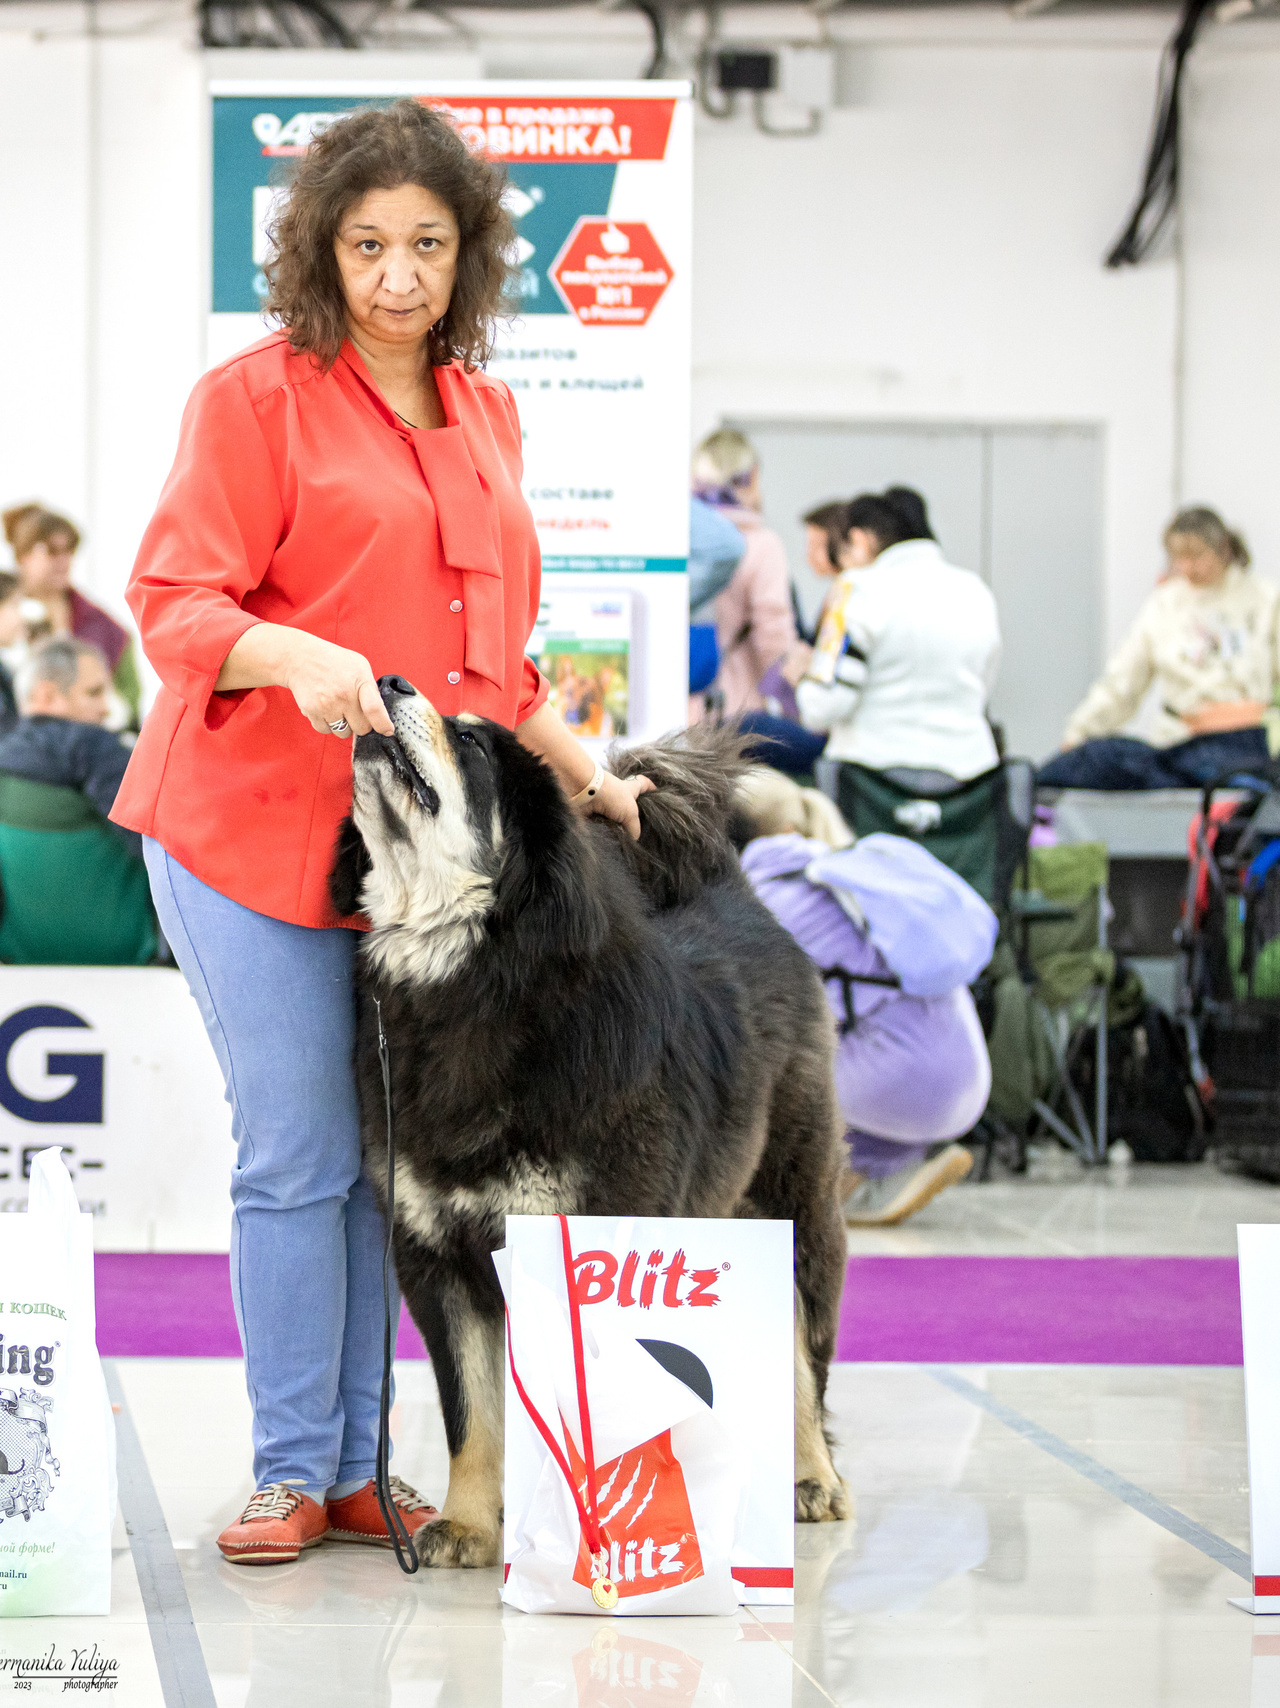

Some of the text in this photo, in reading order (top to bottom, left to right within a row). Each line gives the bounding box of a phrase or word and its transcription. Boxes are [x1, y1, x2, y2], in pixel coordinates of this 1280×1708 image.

[461, 124, 632, 156] ОВИНКА!
[572, 1248, 722, 1310] Blitz
[10, 1302, 67, 1321] КОШЕК
[18, 1541, 56, 1557] форме!
